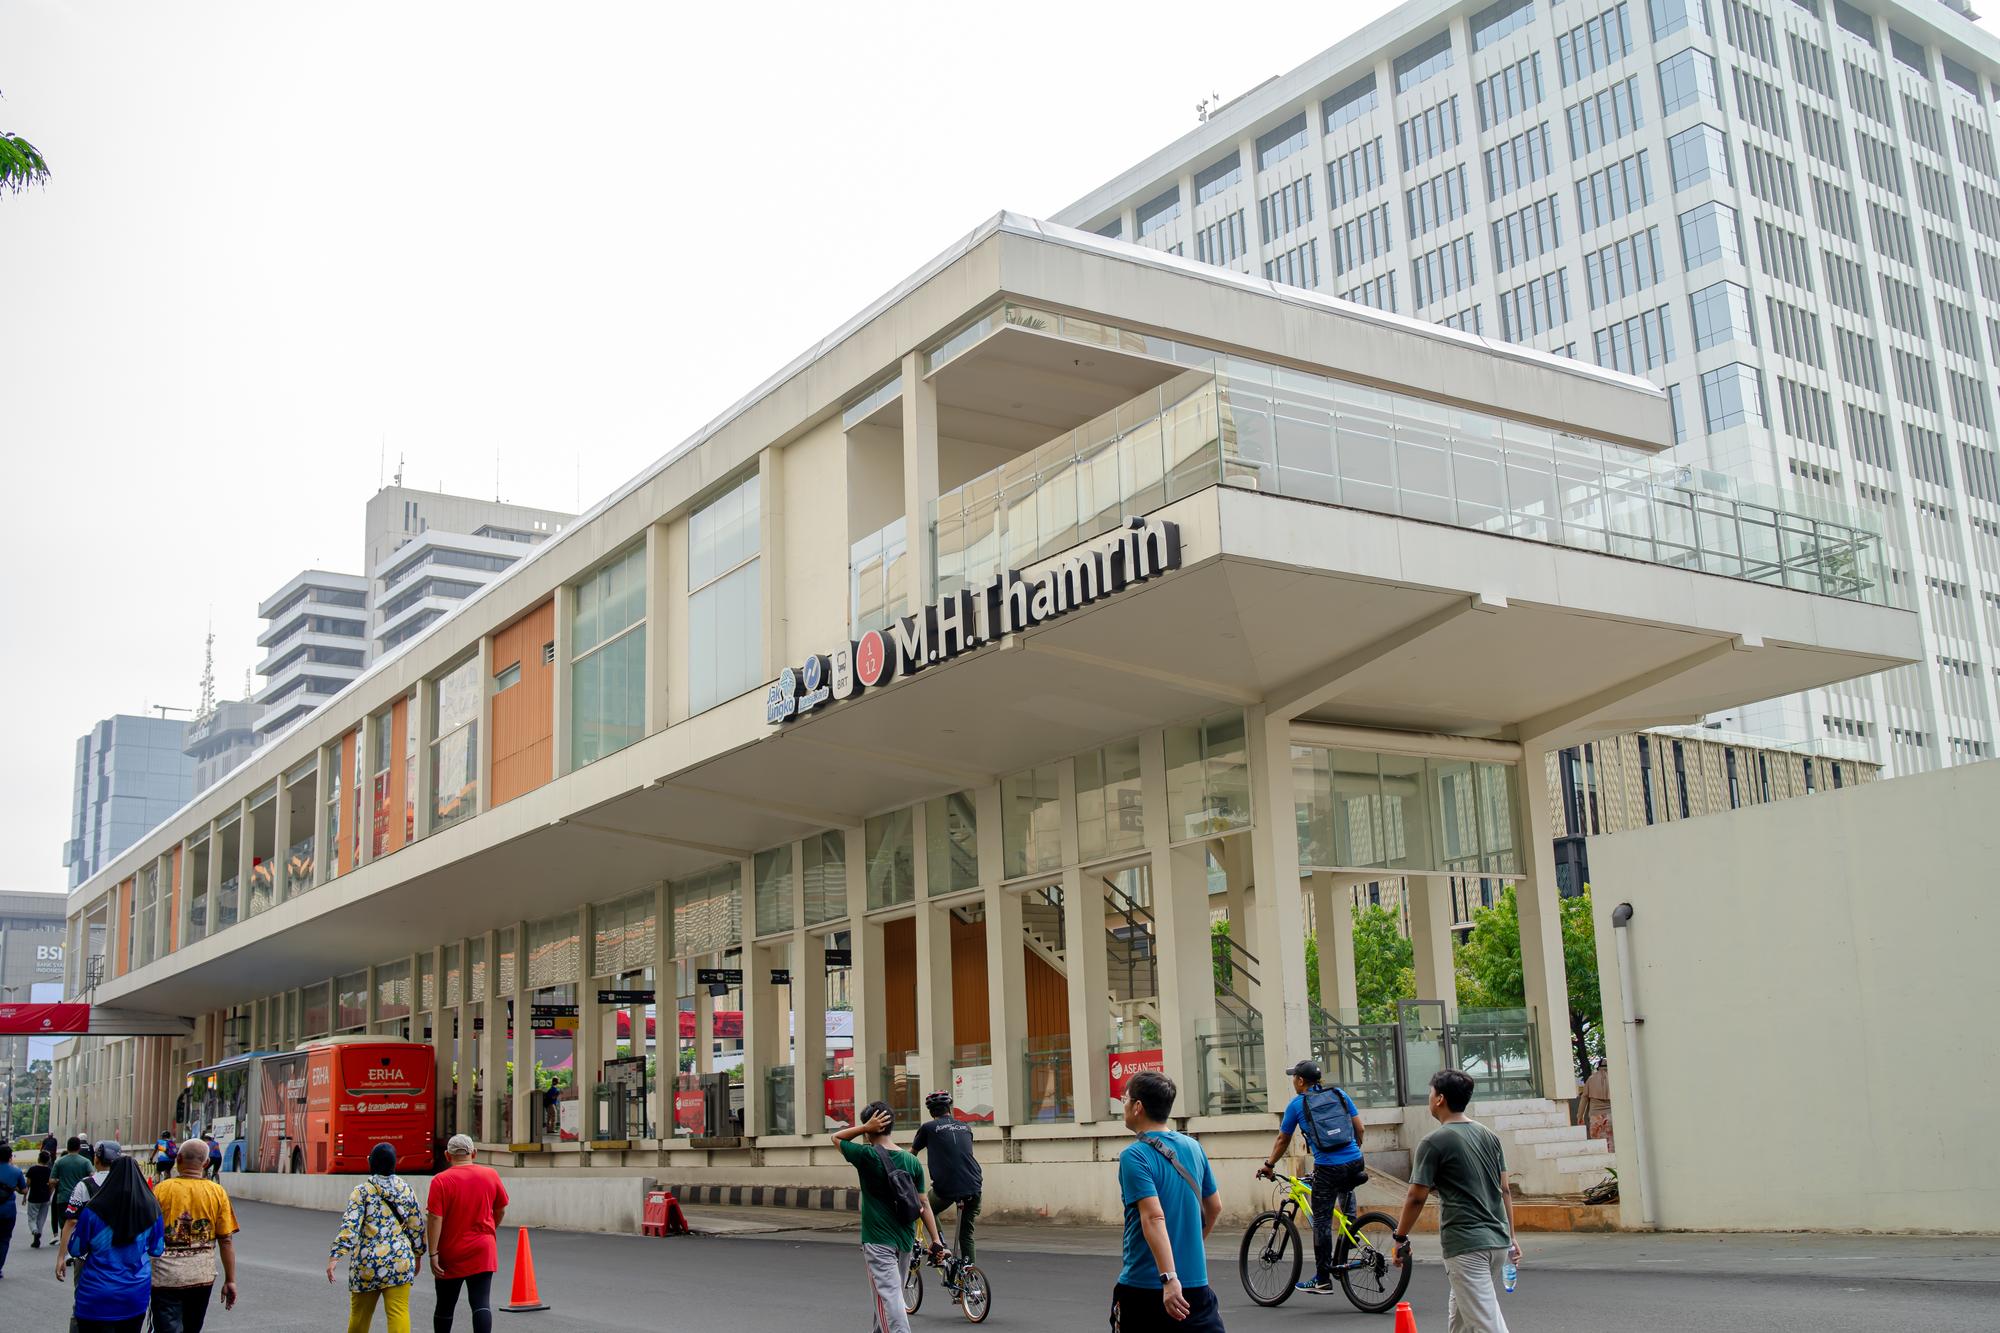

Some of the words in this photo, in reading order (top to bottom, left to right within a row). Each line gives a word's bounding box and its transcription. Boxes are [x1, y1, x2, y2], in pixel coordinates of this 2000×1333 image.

[866, 641, 873, 656] 1
[865, 658, 877, 675] 12
[837, 676, 849, 690] BRT
[767, 684, 782, 704] Jak
[767, 697, 794, 720] Lingko
[37, 945, 63, 960] BSI
[313, 1066, 329, 1086] ERHA
[368, 1069, 404, 1080] ERHA
[1123, 1062, 1148, 1075] ASEAN
[367, 1102, 409, 1112] transjakarta
